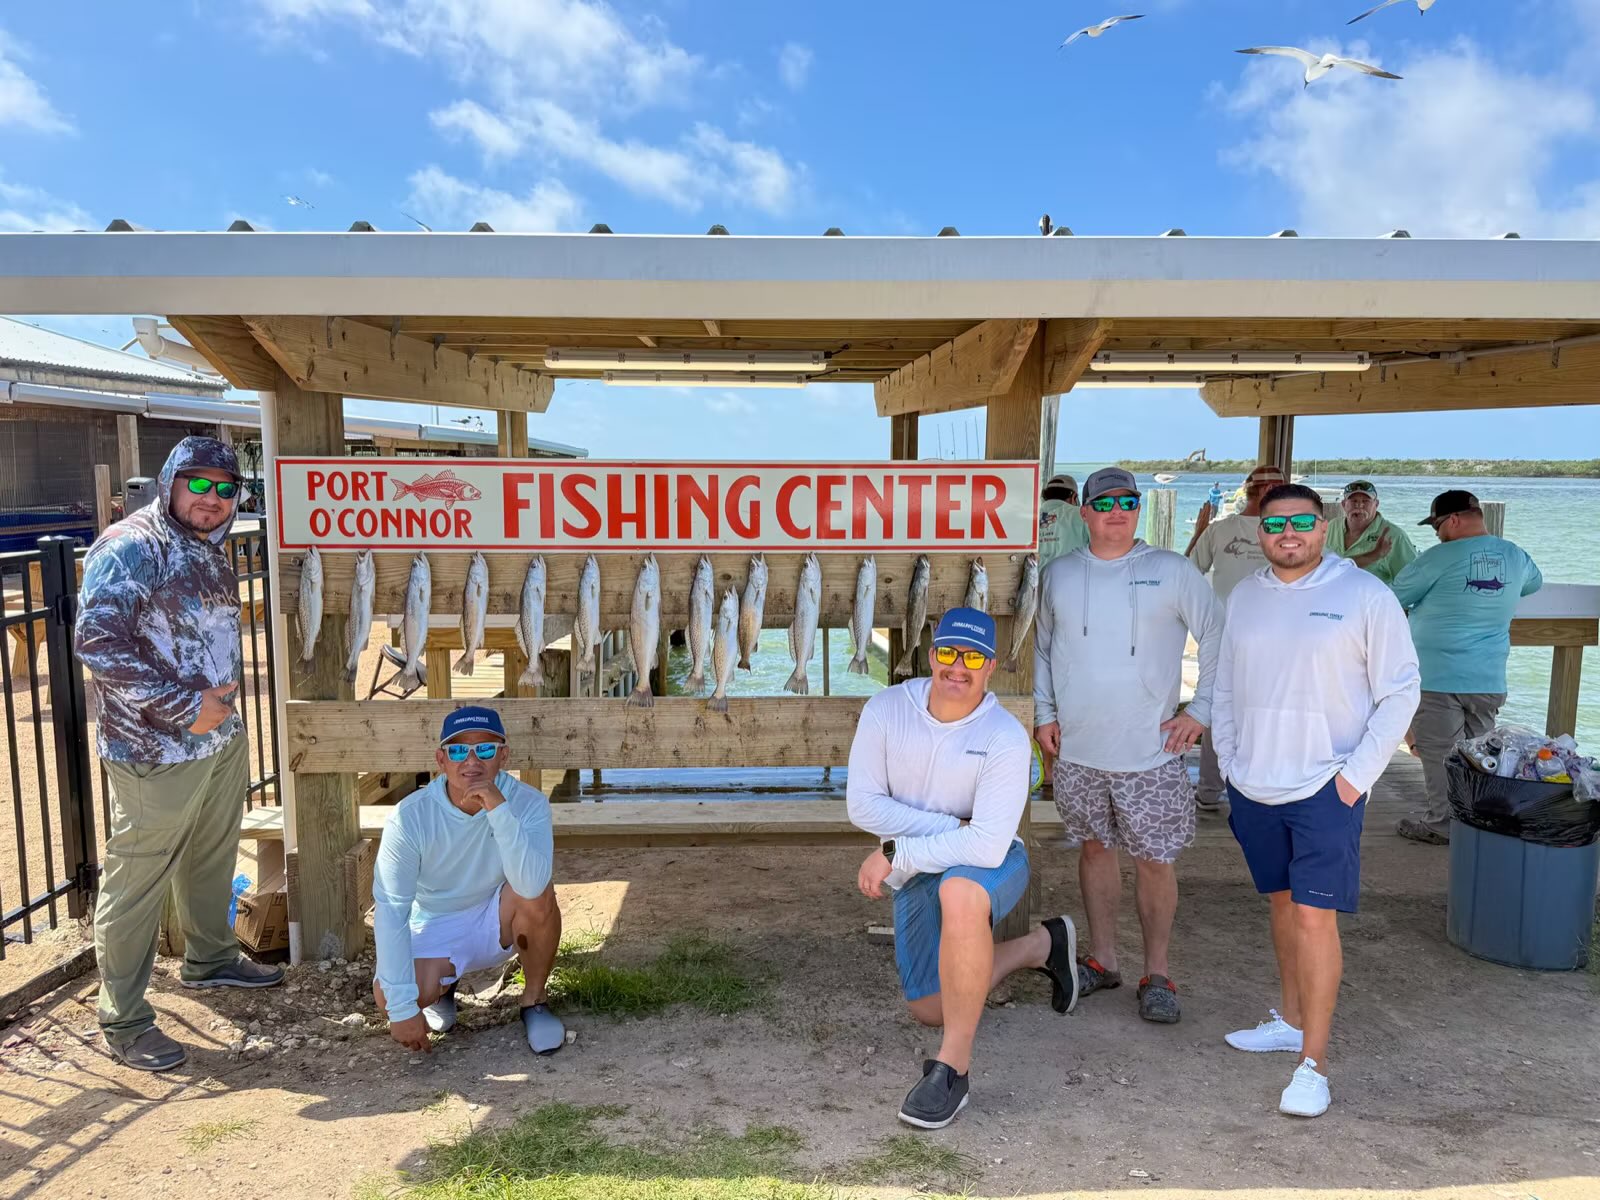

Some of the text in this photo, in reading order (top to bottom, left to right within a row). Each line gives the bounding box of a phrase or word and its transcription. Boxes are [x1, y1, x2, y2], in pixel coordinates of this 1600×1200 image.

[307, 471, 388, 501] PORT
[503, 473, 1007, 539] FISHING CENTER
[309, 508, 473, 538] O'CONNOR
